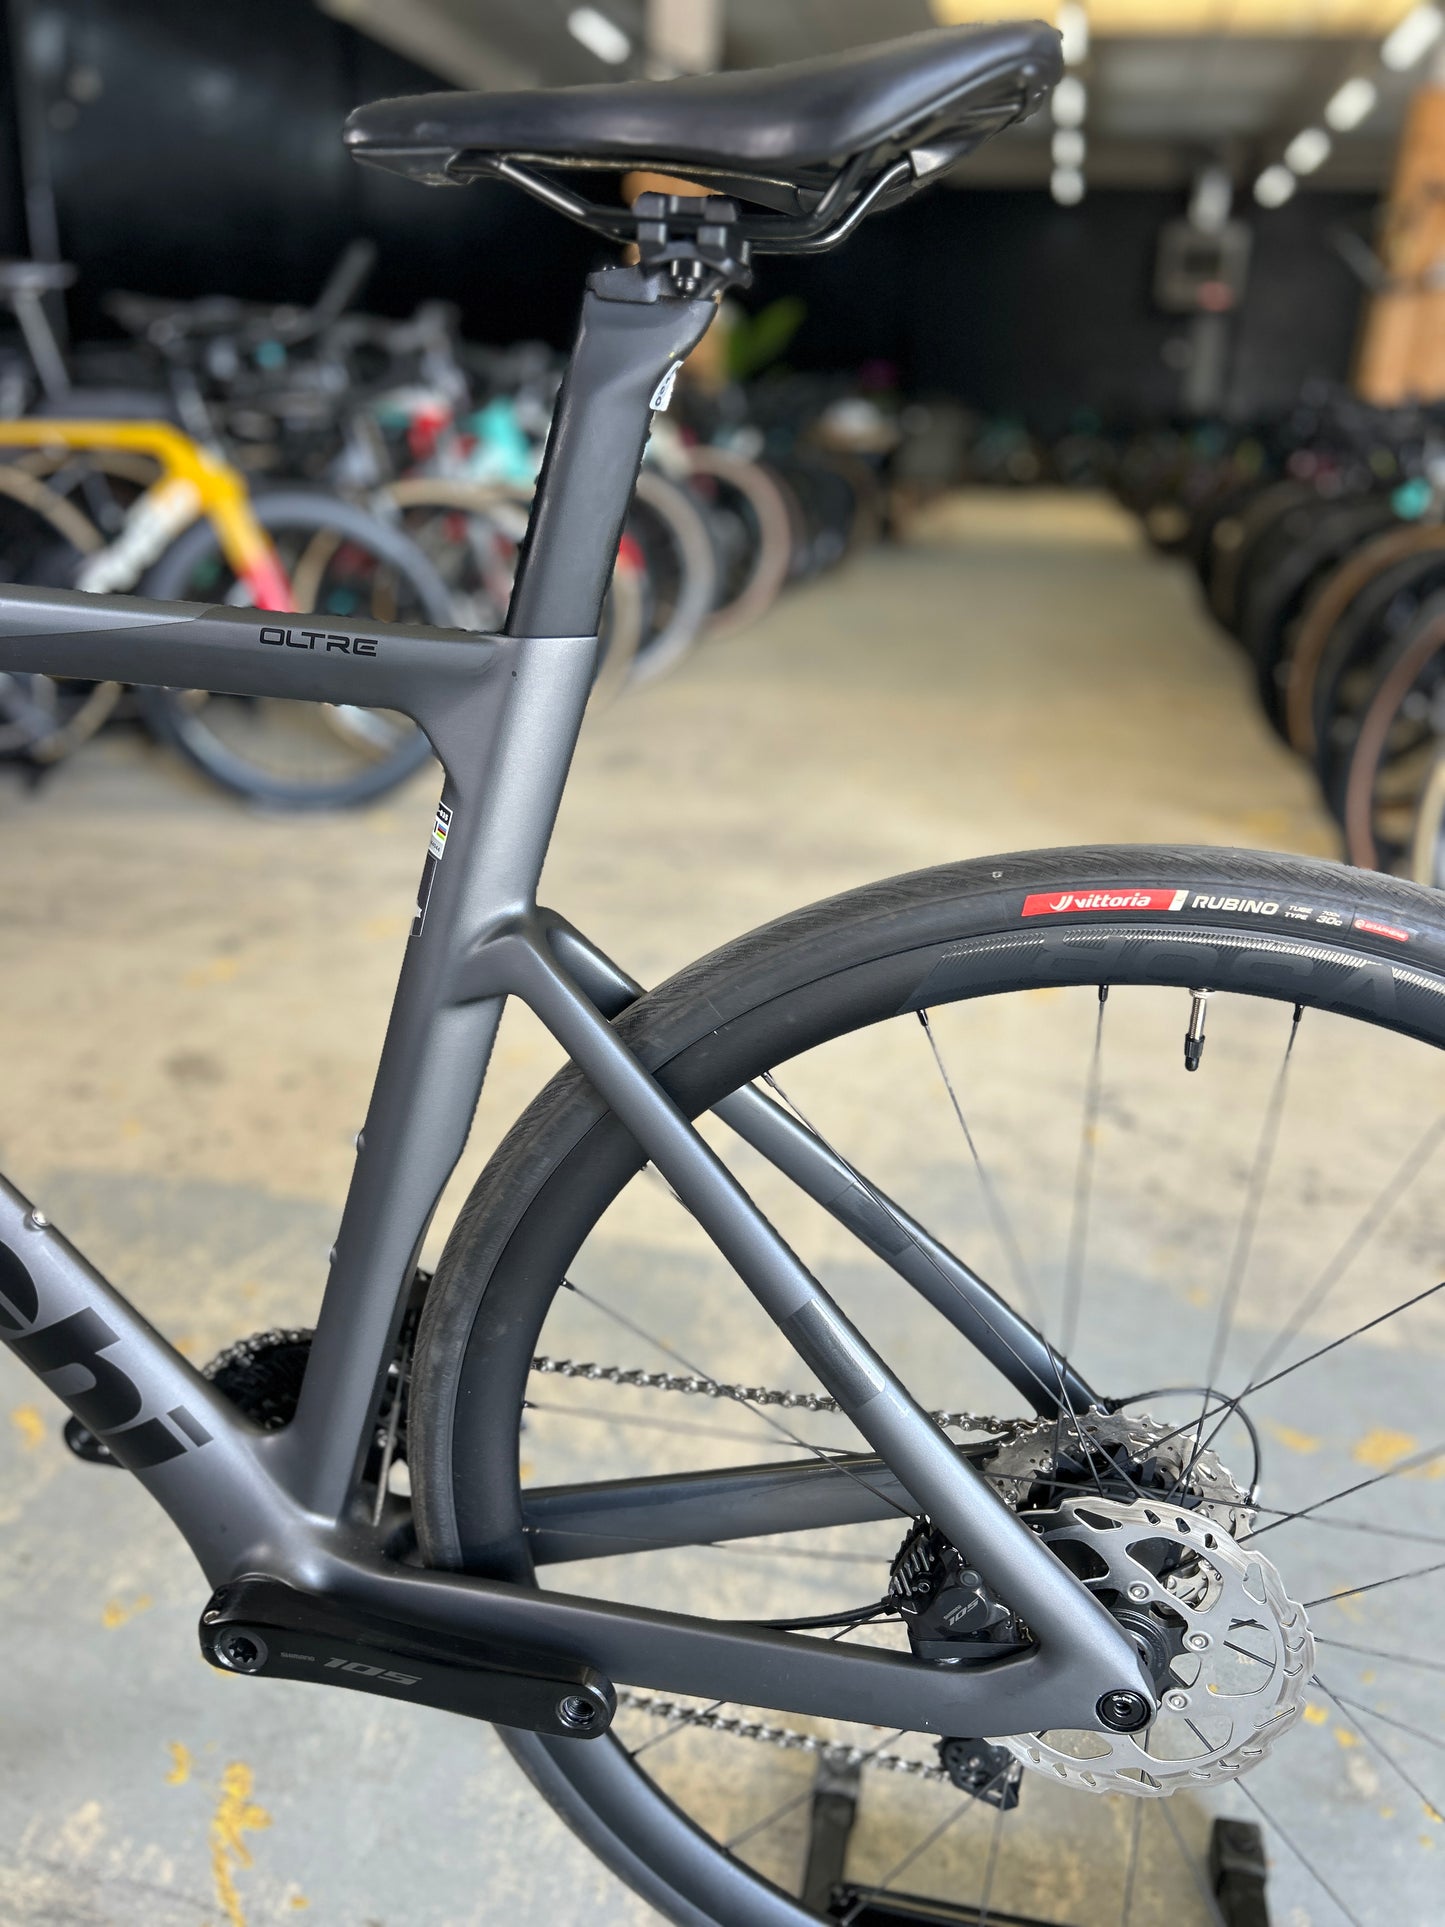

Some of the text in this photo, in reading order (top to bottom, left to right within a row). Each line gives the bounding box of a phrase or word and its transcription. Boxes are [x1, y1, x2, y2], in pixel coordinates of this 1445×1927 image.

[260, 627, 378, 657] OLTRE
[1074, 892, 1152, 908] vittoria
[1191, 895, 1280, 915] RUBINO
[1289, 905, 1313, 914] TUBE
[1284, 911, 1309, 921] TYPE
[948, 1598, 979, 1627] 105
[323, 1657, 423, 1686] 105
